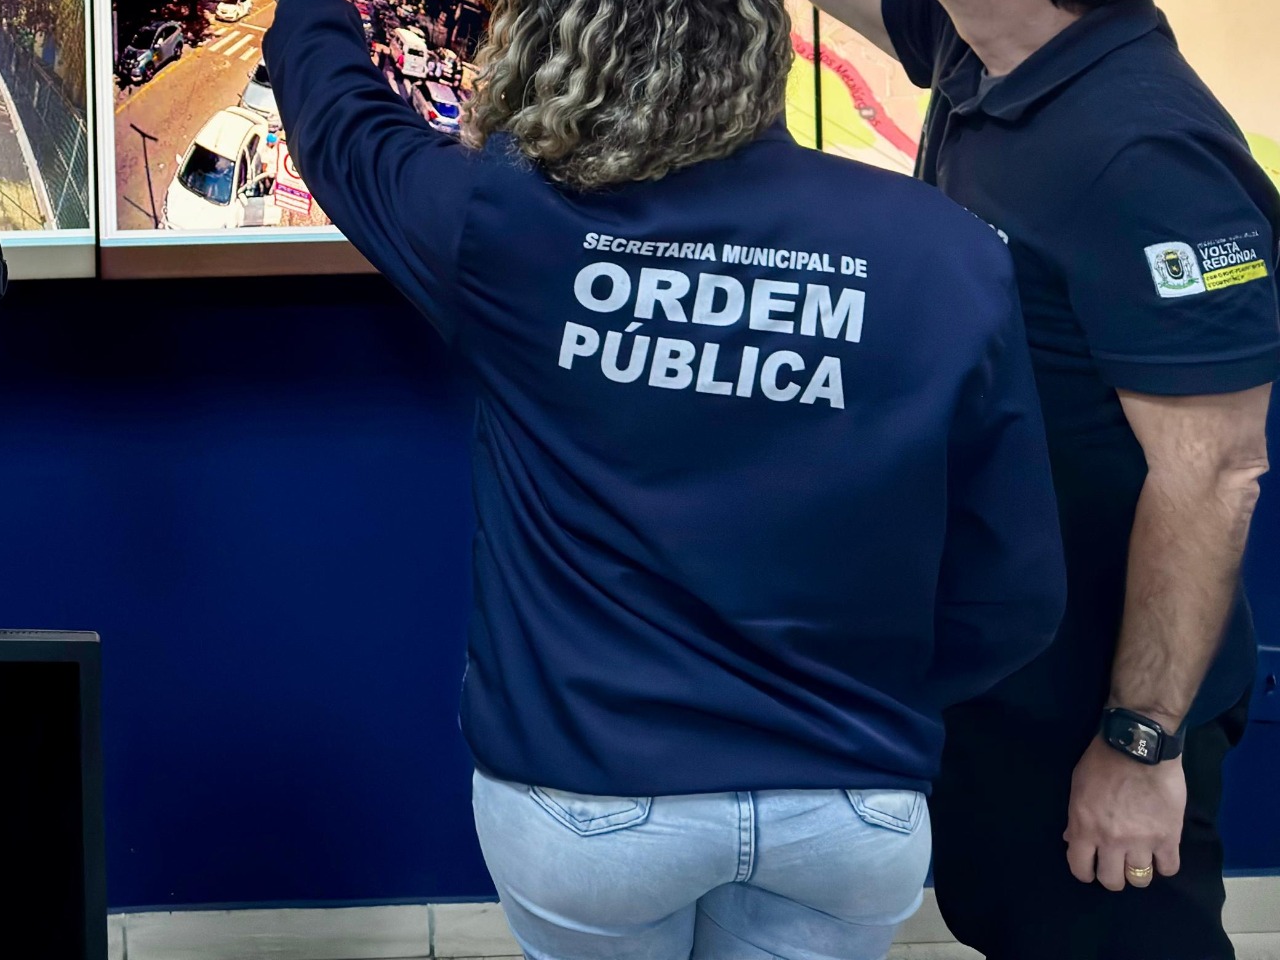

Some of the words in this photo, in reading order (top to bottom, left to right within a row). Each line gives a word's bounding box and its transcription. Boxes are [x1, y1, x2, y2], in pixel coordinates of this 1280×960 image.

[583, 232, 717, 262] SECRETARIA
[722, 244, 835, 273] MUNICIPAL
[841, 255, 868, 278] DE
[1199, 241, 1241, 260] VOLTA
[1202, 248, 1257, 272] REDONDA
[573, 261, 866, 344] ORDEM
[558, 321, 845, 410] PÚBLICA
